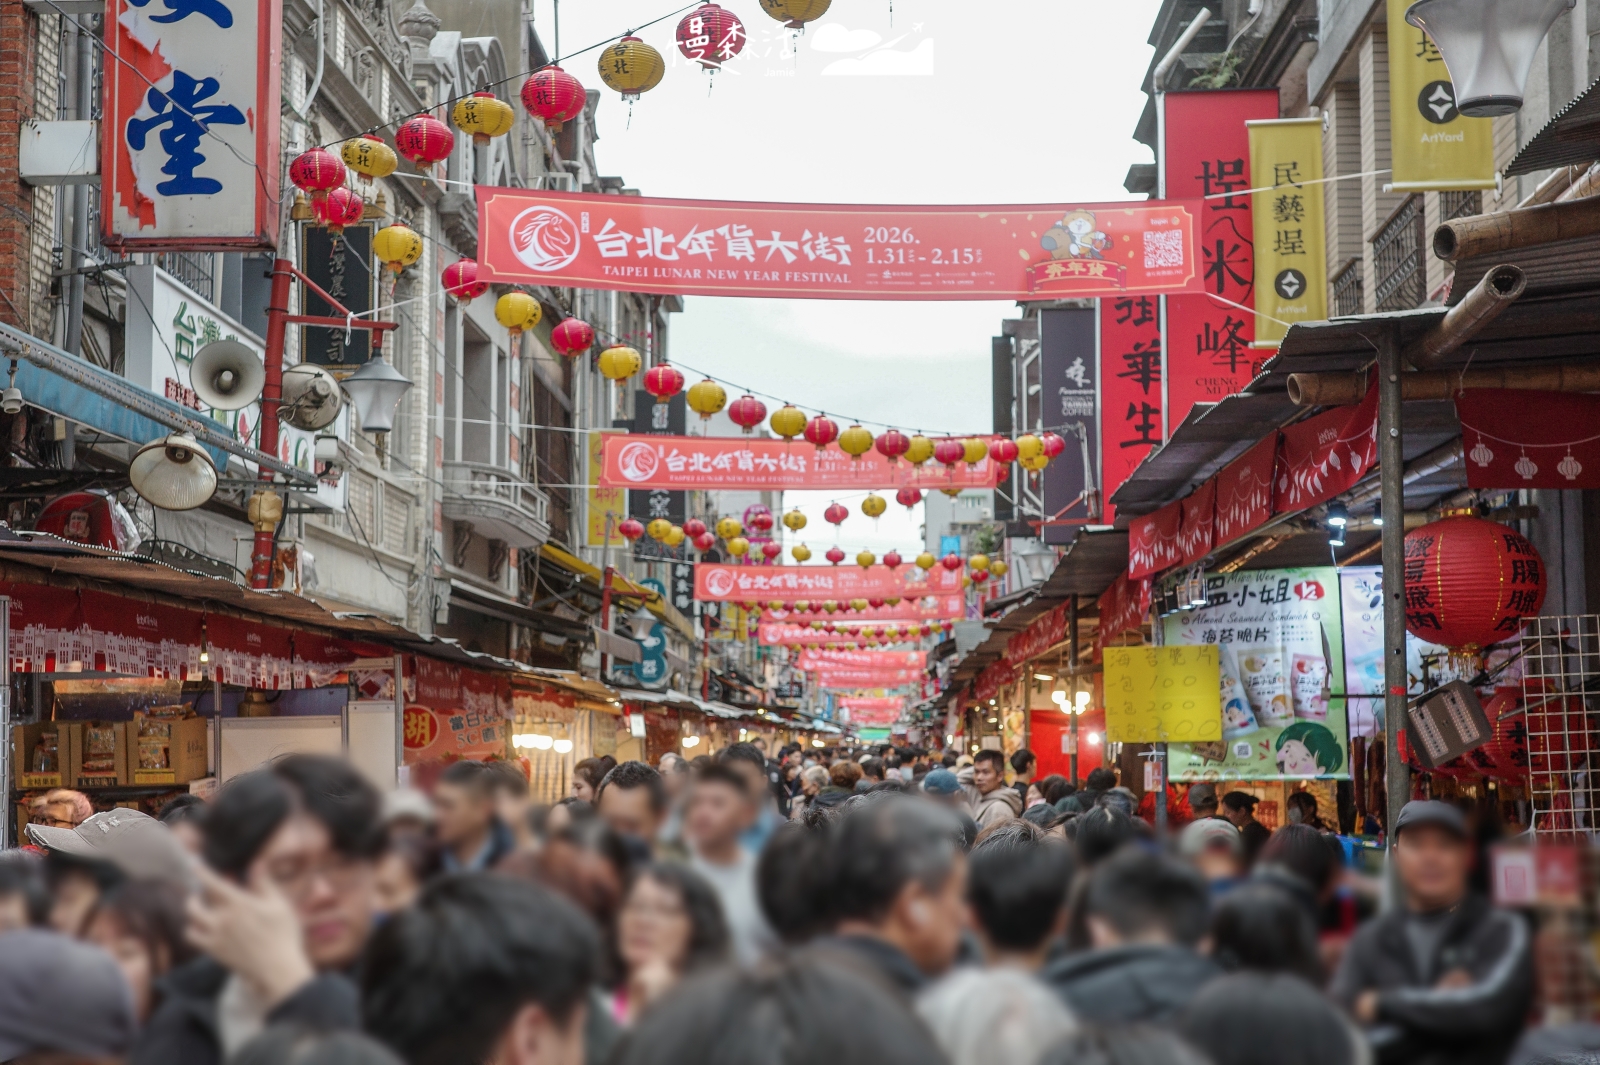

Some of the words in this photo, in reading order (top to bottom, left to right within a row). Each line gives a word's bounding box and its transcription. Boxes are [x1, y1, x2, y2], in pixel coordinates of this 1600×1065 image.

[614, 45, 629, 74] 台北
[535, 75, 551, 105] 台北
[465, 100, 479, 124] 台北
[408, 122, 423, 150] 台北
[1421, 130, 1464, 143] ArtYard
[357, 143, 373, 167] 台北
[302, 155, 316, 180] 台北
[1273, 161, 1306, 256] 民藝埕
[593, 218, 851, 266] 台北年貨大街
[864, 227, 920, 244] 2026.
[866, 248, 905, 264] 1.31
[931, 248, 974, 264] 2.15
[602, 265, 648, 277] TAIPEI
[653, 267, 701, 279] LUNAR
[706, 269, 739, 280] NEW
[743, 270, 780, 282] YEAR
[785, 271, 851, 283] FESTIVAL
[1196, 377, 1238, 387] CHENG
[1206, 386, 1222, 394] MI
[1062, 408, 1093, 416] COFFEE
[665, 448, 807, 473] 台北年貨大街
[1192, 613, 1223, 625] Almond
[1227, 612, 1265, 624] Seaweed
[1268, 610, 1309, 622] Sandwich
[1203, 627, 1270, 643] 海苔脆片
